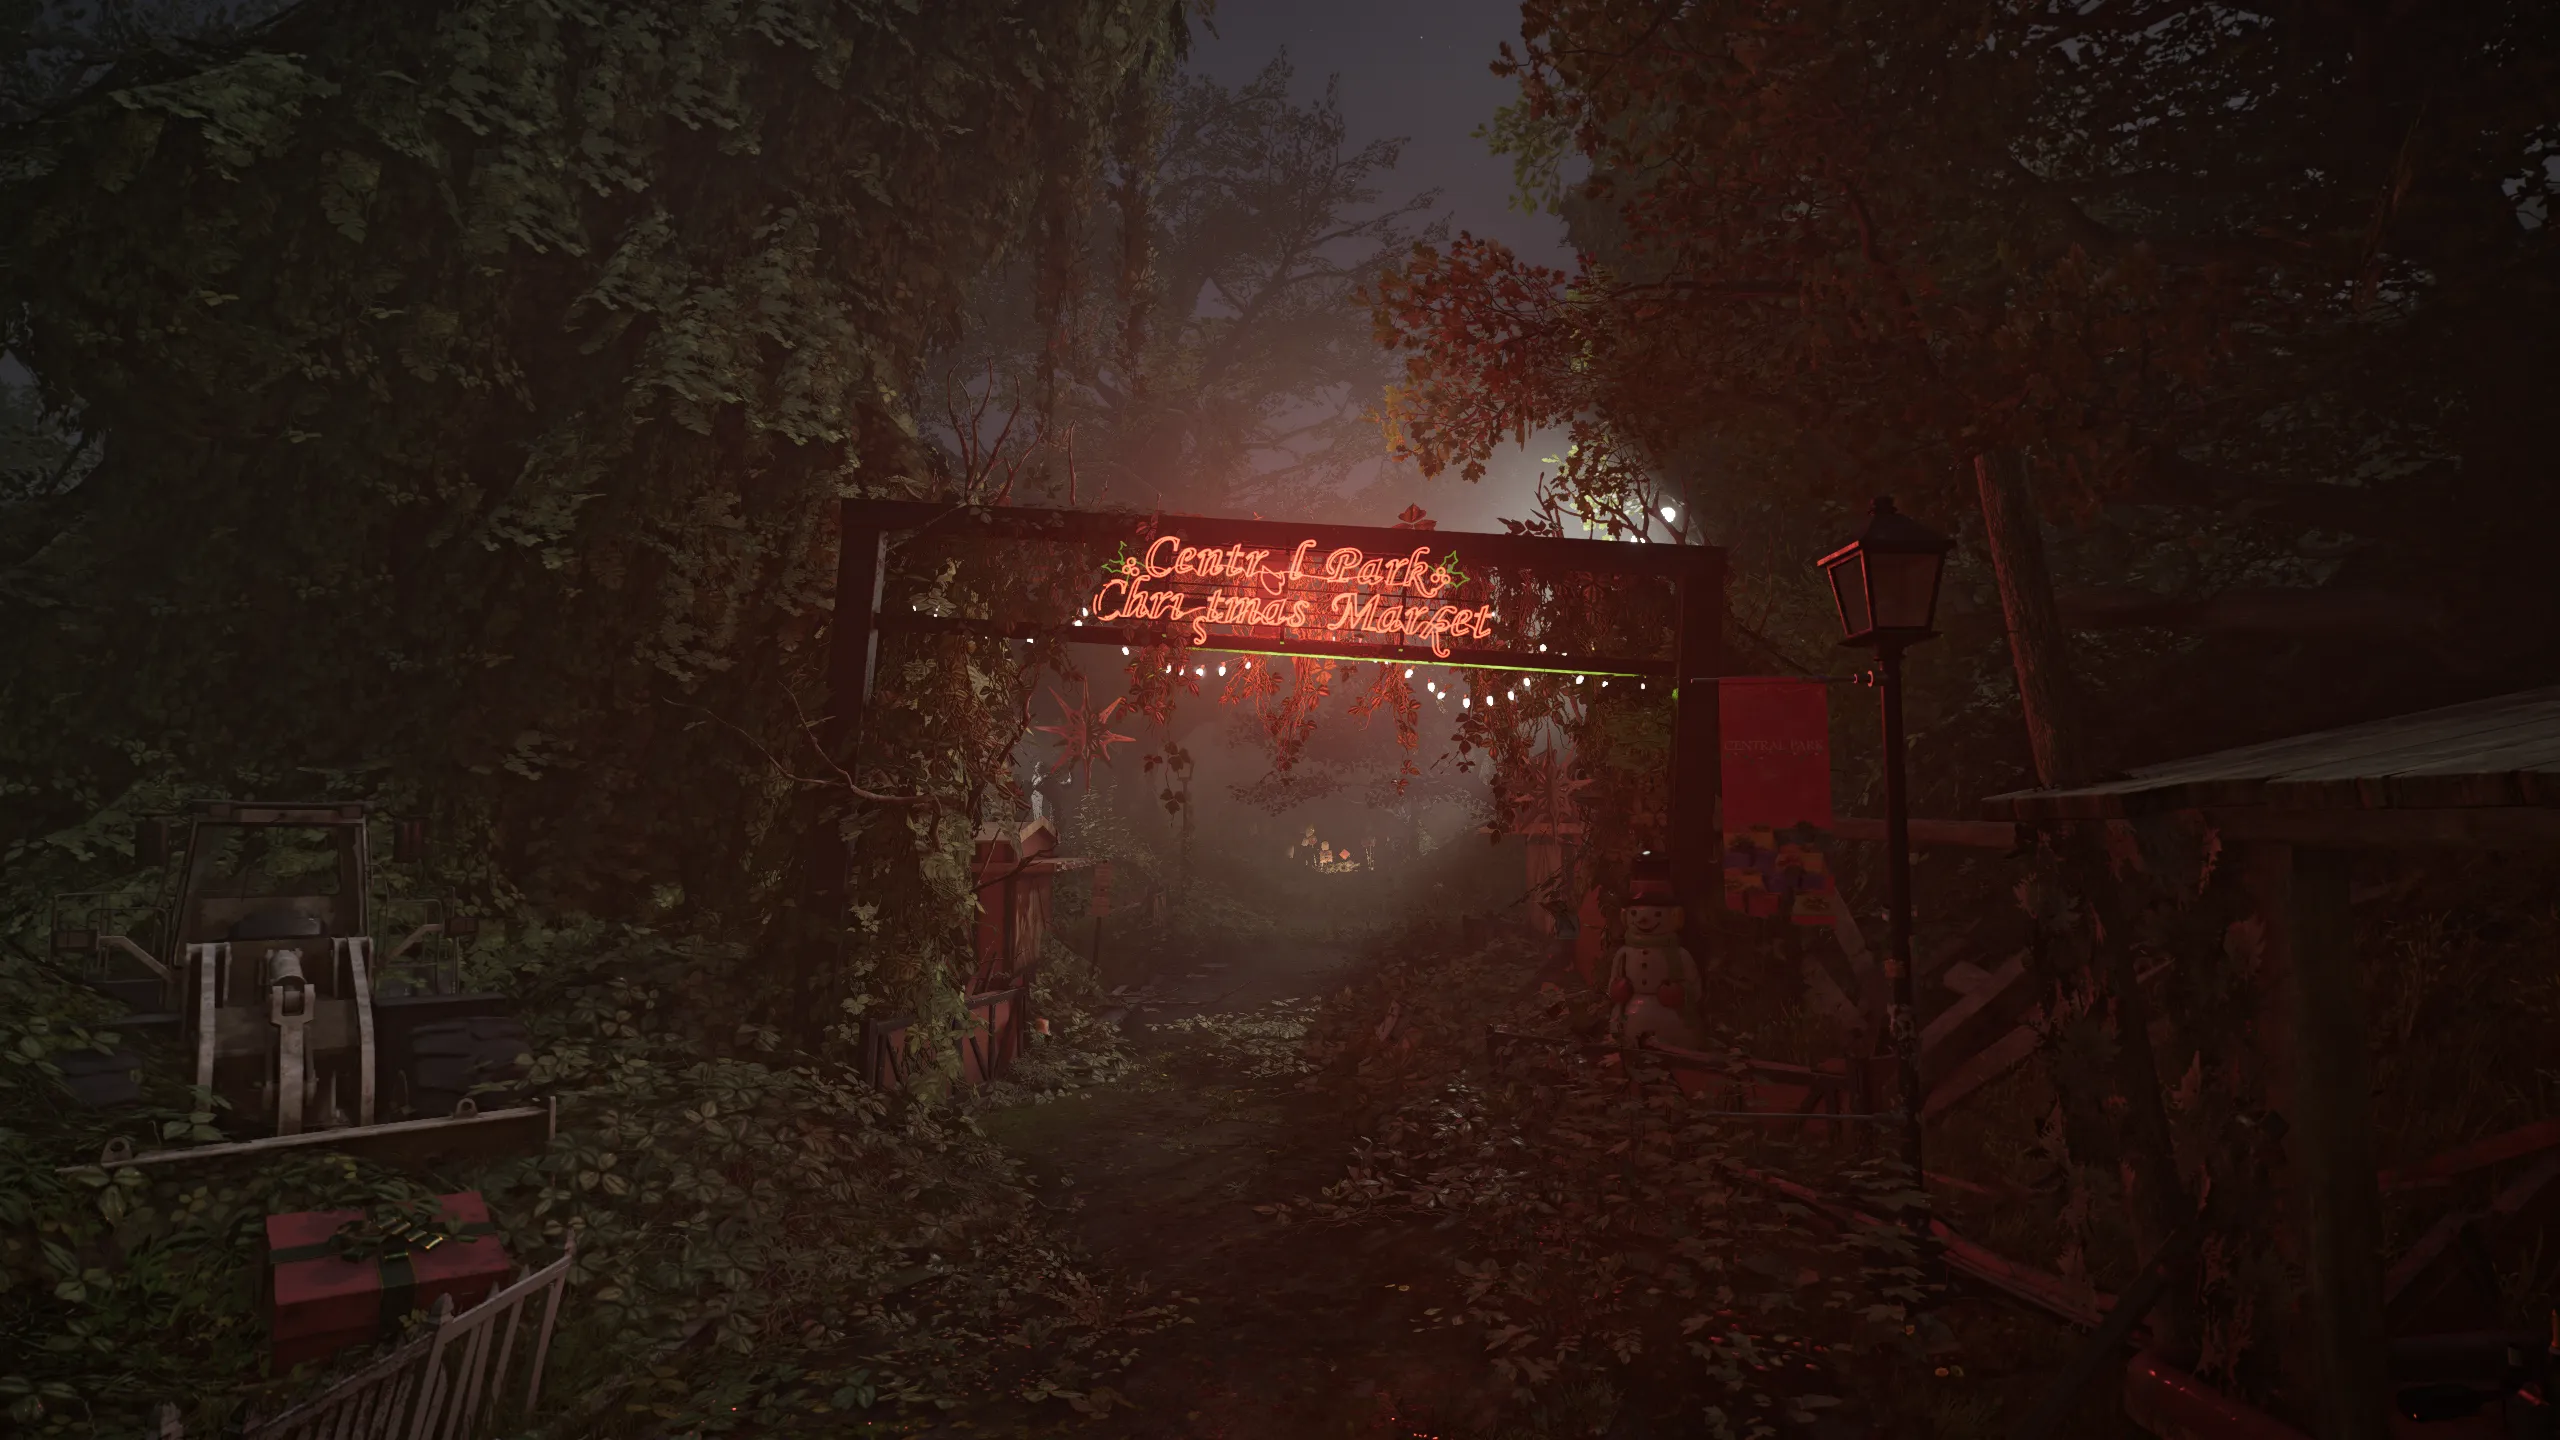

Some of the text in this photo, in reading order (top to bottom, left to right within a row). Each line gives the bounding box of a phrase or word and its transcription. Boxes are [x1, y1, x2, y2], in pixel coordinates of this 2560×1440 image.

[1326, 546, 1436, 598] Park
[1327, 592, 1492, 658] Market
[1724, 739, 1824, 752] CENTRAL PARK
